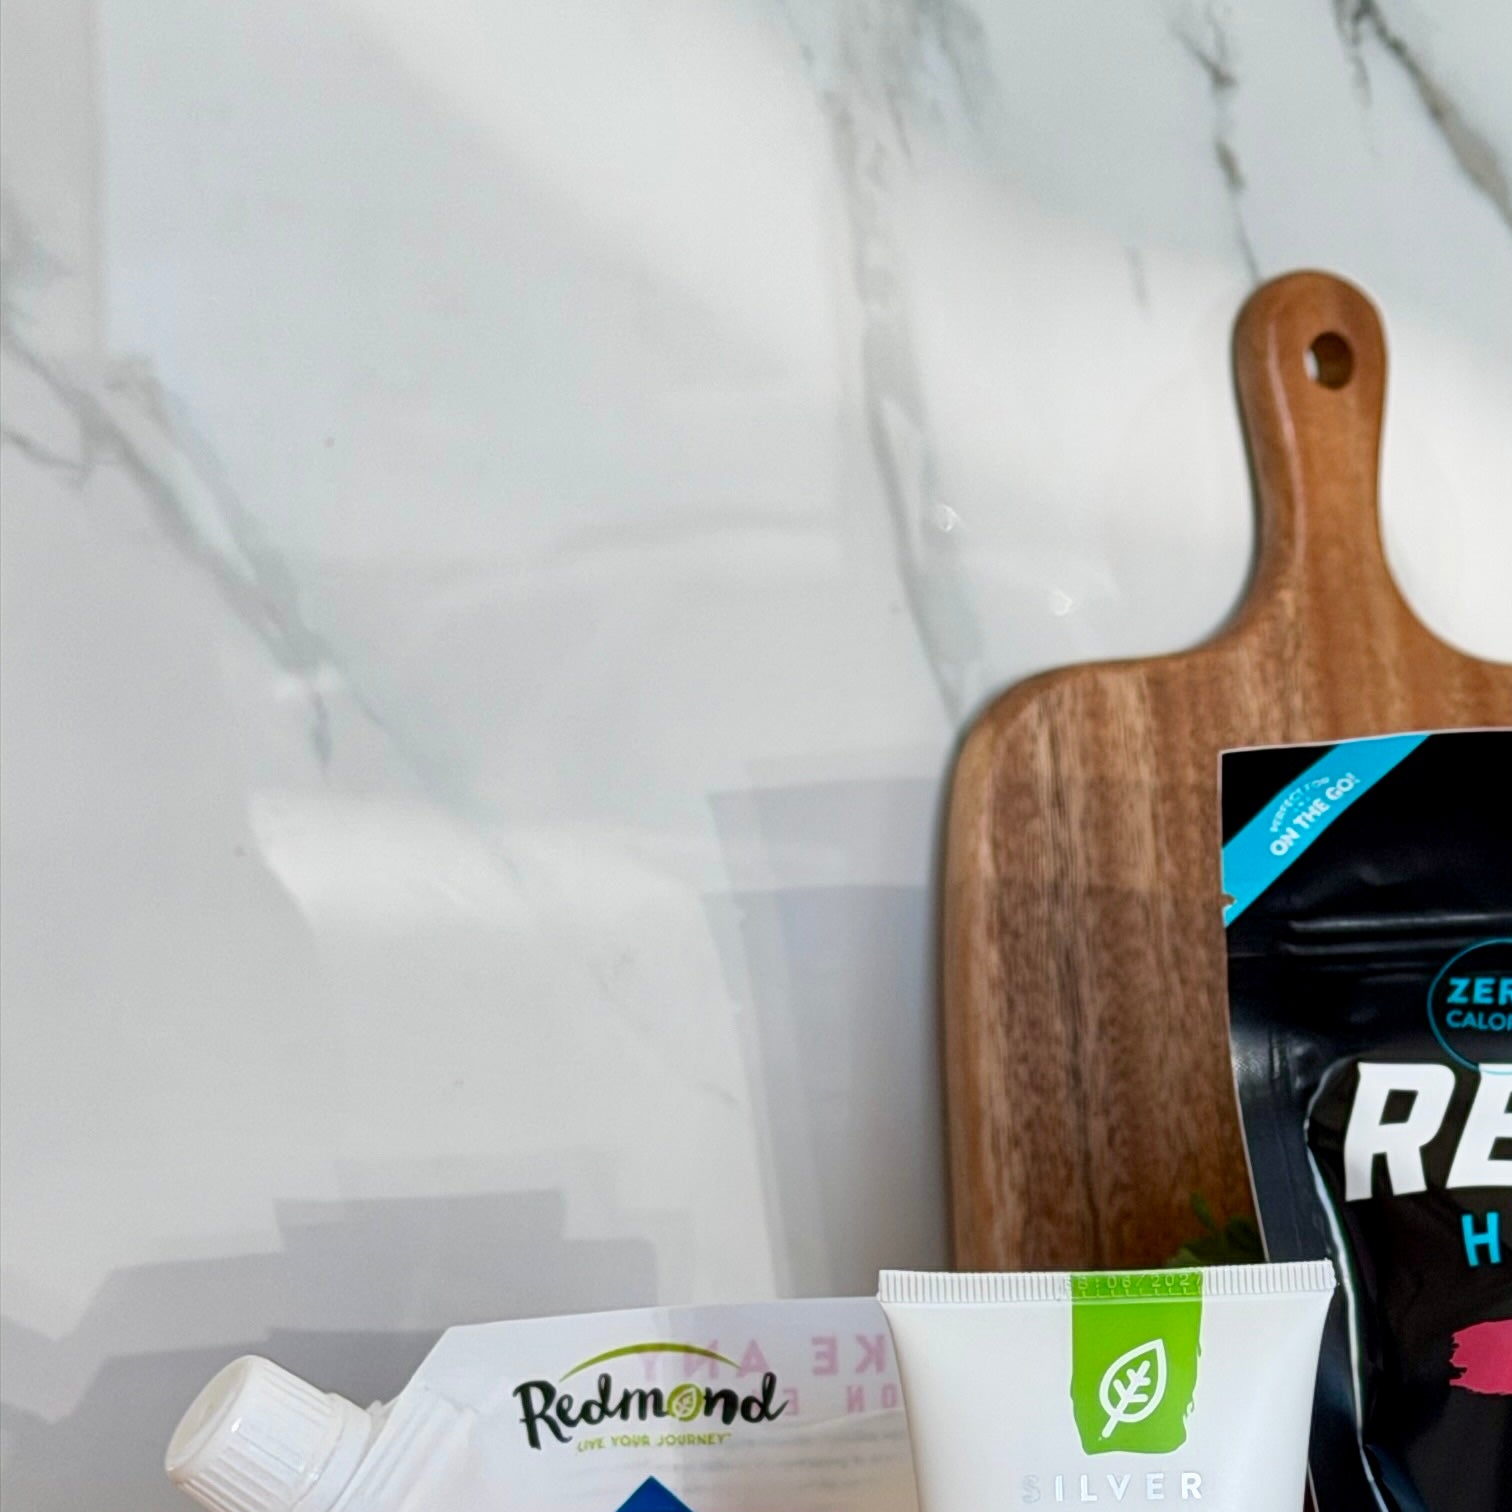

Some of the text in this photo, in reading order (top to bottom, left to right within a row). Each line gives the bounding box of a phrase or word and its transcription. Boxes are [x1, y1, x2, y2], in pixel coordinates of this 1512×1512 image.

[1269, 772, 1361, 856] ON THE GO!
[512, 1371, 790, 1450] Redmond
[576, 1433, 726, 1453] LIVE YOUR JOURNEY
[1021, 1472, 1204, 1504] SILVER
